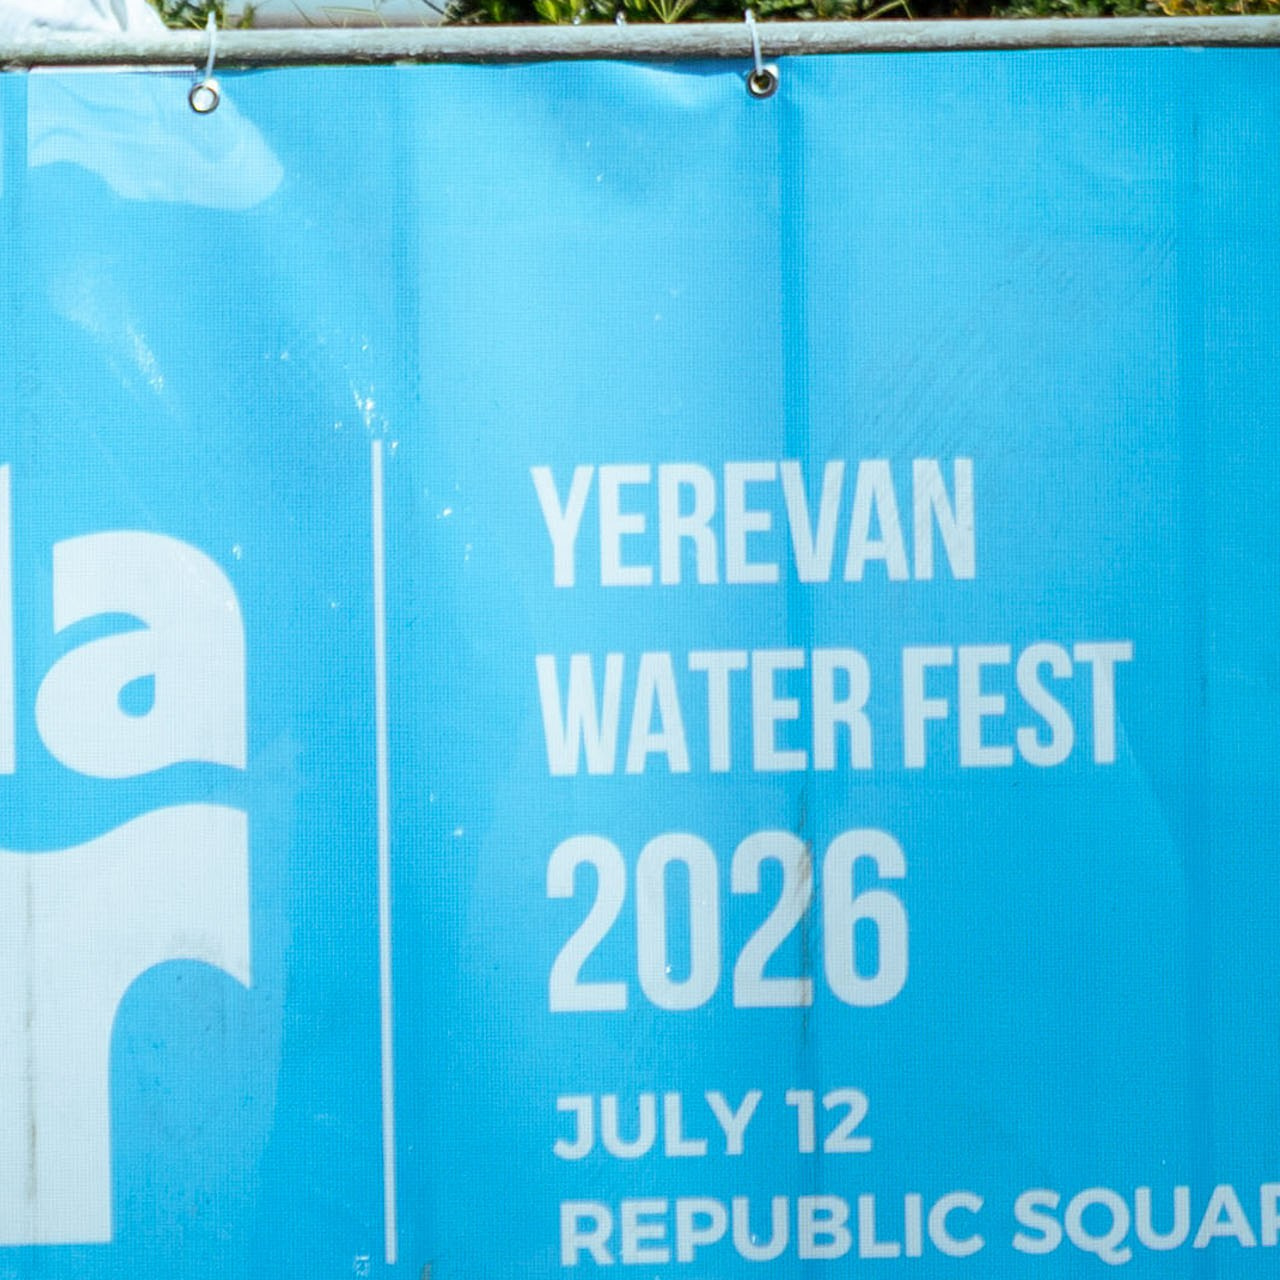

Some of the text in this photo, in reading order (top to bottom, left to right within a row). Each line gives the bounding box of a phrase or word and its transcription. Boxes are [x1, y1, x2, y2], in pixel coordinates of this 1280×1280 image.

[530, 458, 976, 588] YEREVAN
[535, 641, 1133, 776] WATER FEST
[546, 830, 908, 1012] 2026
[554, 1088, 872, 1160] JULY 12
[560, 1192, 984, 1266] REPUBLIC
